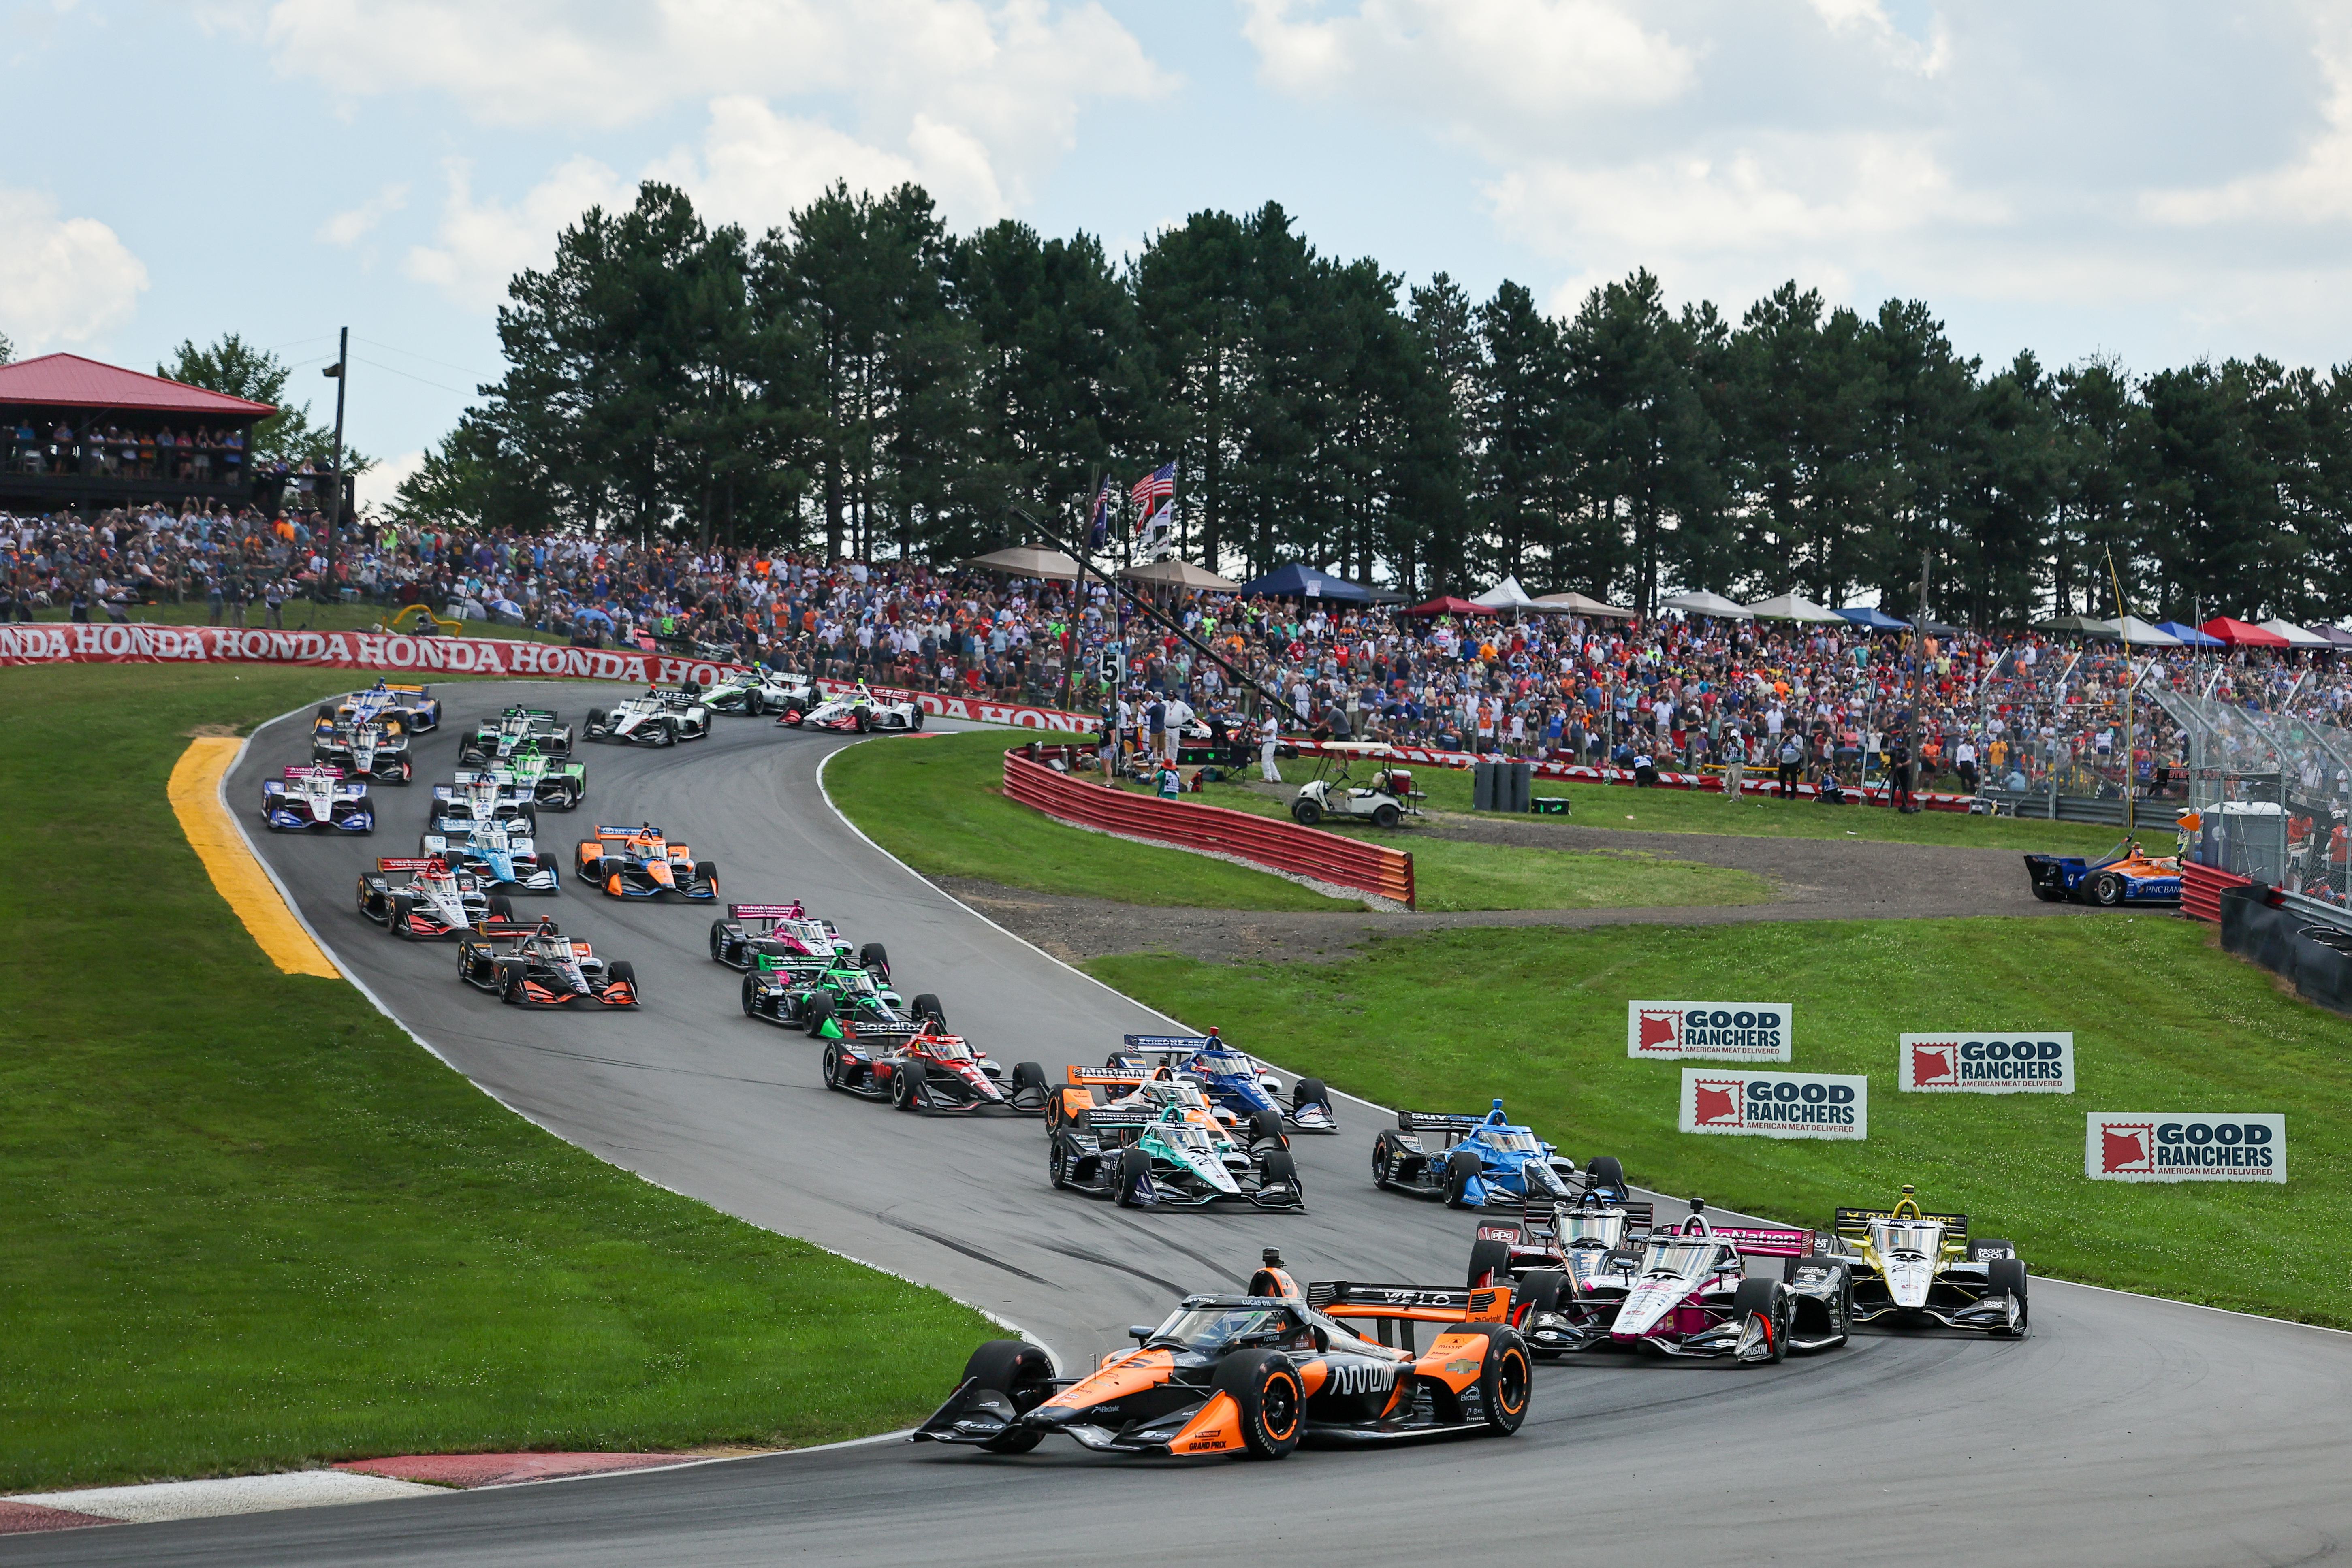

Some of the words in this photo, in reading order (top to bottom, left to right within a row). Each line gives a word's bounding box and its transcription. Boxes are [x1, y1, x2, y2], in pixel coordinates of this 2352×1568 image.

[73, 625, 207, 659] HONDA
[212, 629, 353, 661] HONDA
[357, 634, 506, 673] HONDA
[510, 644, 648, 681] HONDA
[1101, 655, 1119, 683] 5
[2068, 873, 2075, 886] 9
[855, 1021, 921, 1031] GoodRx
[1686, 1011, 1781, 1028] GOOD
[1686, 1029, 1780, 1047] RANCHERS
[1961, 1041, 2062, 1060] GOOD
[1961, 1061, 2062, 1079] RANCHERS
[1747, 1081, 1855, 1104] GOOD
[1088, 1111, 1143, 1122] Delaware
[1747, 1102, 1855, 1124] RANCHERS
[2157, 1123, 2273, 1145] GOOD
[2158, 1146, 2273, 1167] RANCHERS
[1492, 1231, 1512, 1240] PPG
[1690, 1228, 1796, 1246] AtoNation
[1384, 1292, 1451, 1306] VELO
[1311, 1305, 1328, 1320] LUCAS
[1328, 1315, 1336, 1324] OIL
[1101, 1405, 1119, 1413] Electrolit
[1189, 1442, 1210, 1451] GRAND
[1210, 1440, 1227, 1449] PRIX
[1254, 1417, 1276, 1455] Firestone
